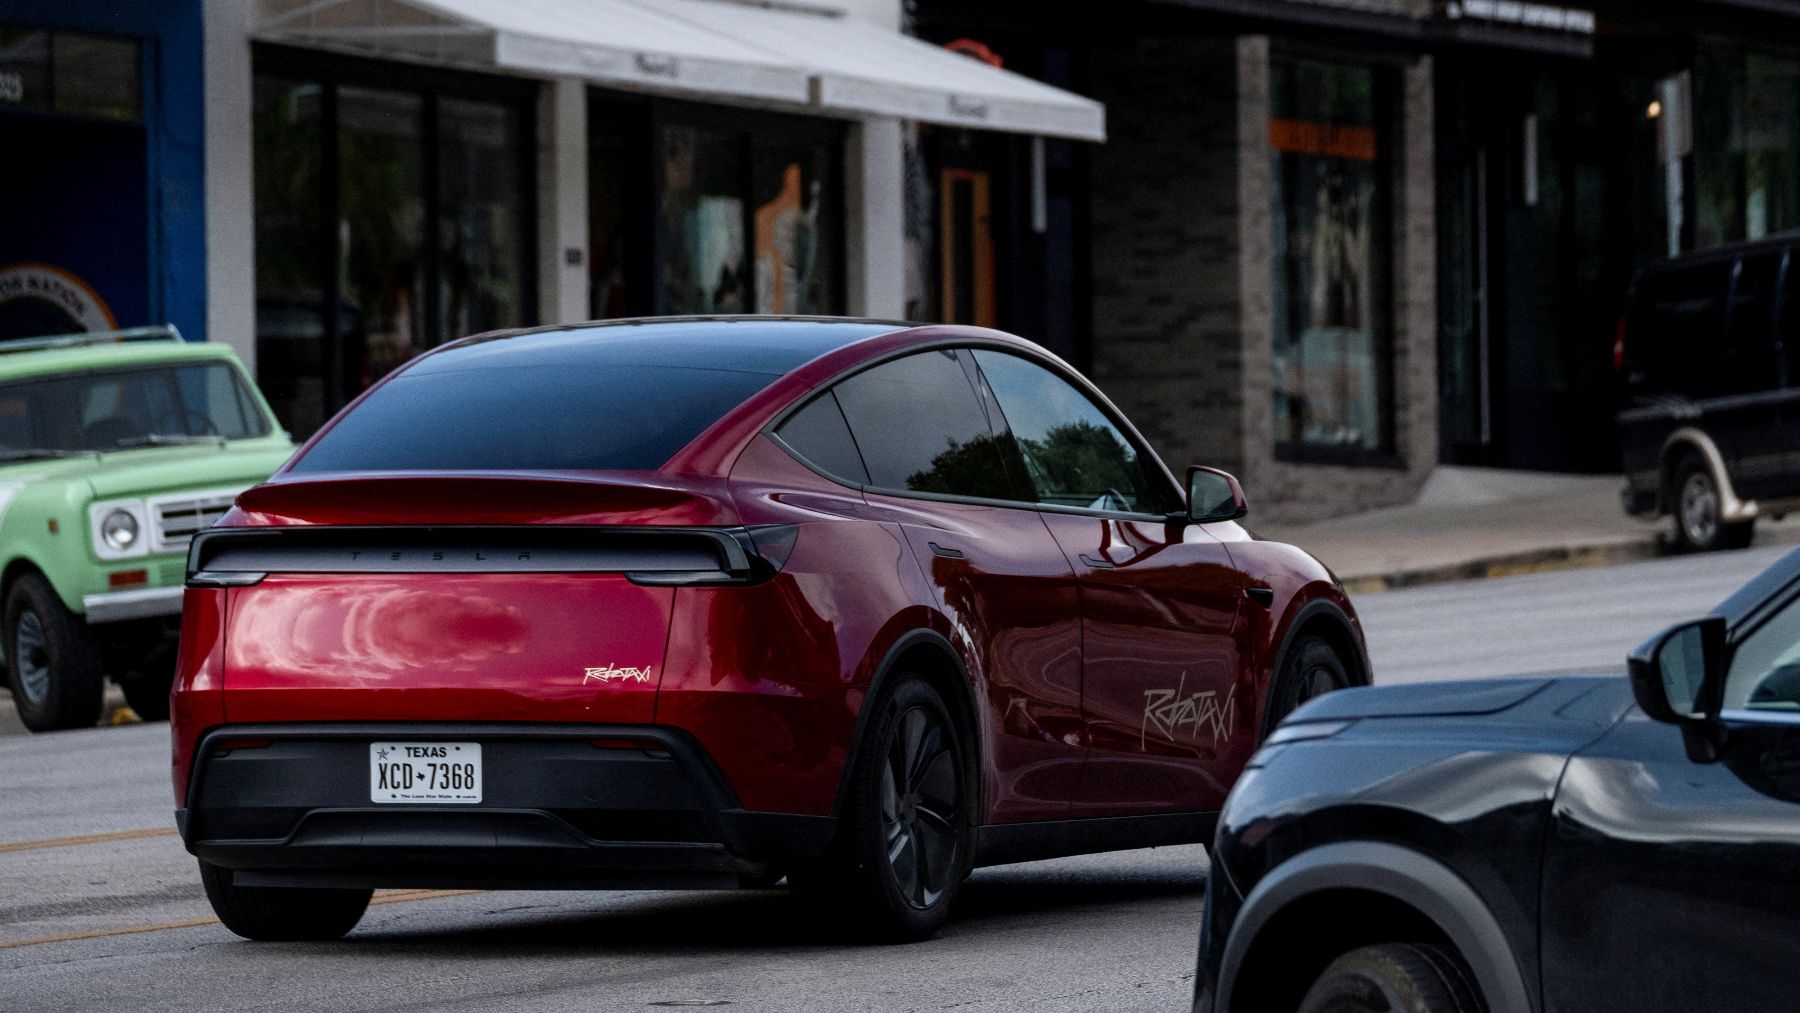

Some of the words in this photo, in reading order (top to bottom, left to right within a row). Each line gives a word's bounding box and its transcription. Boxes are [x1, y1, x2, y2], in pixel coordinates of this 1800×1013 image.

[352, 551, 531, 561] TESLA
[405, 746, 448, 758] TEXAS
[378, 763, 413, 790] XCD
[427, 763, 475, 790] 7368
